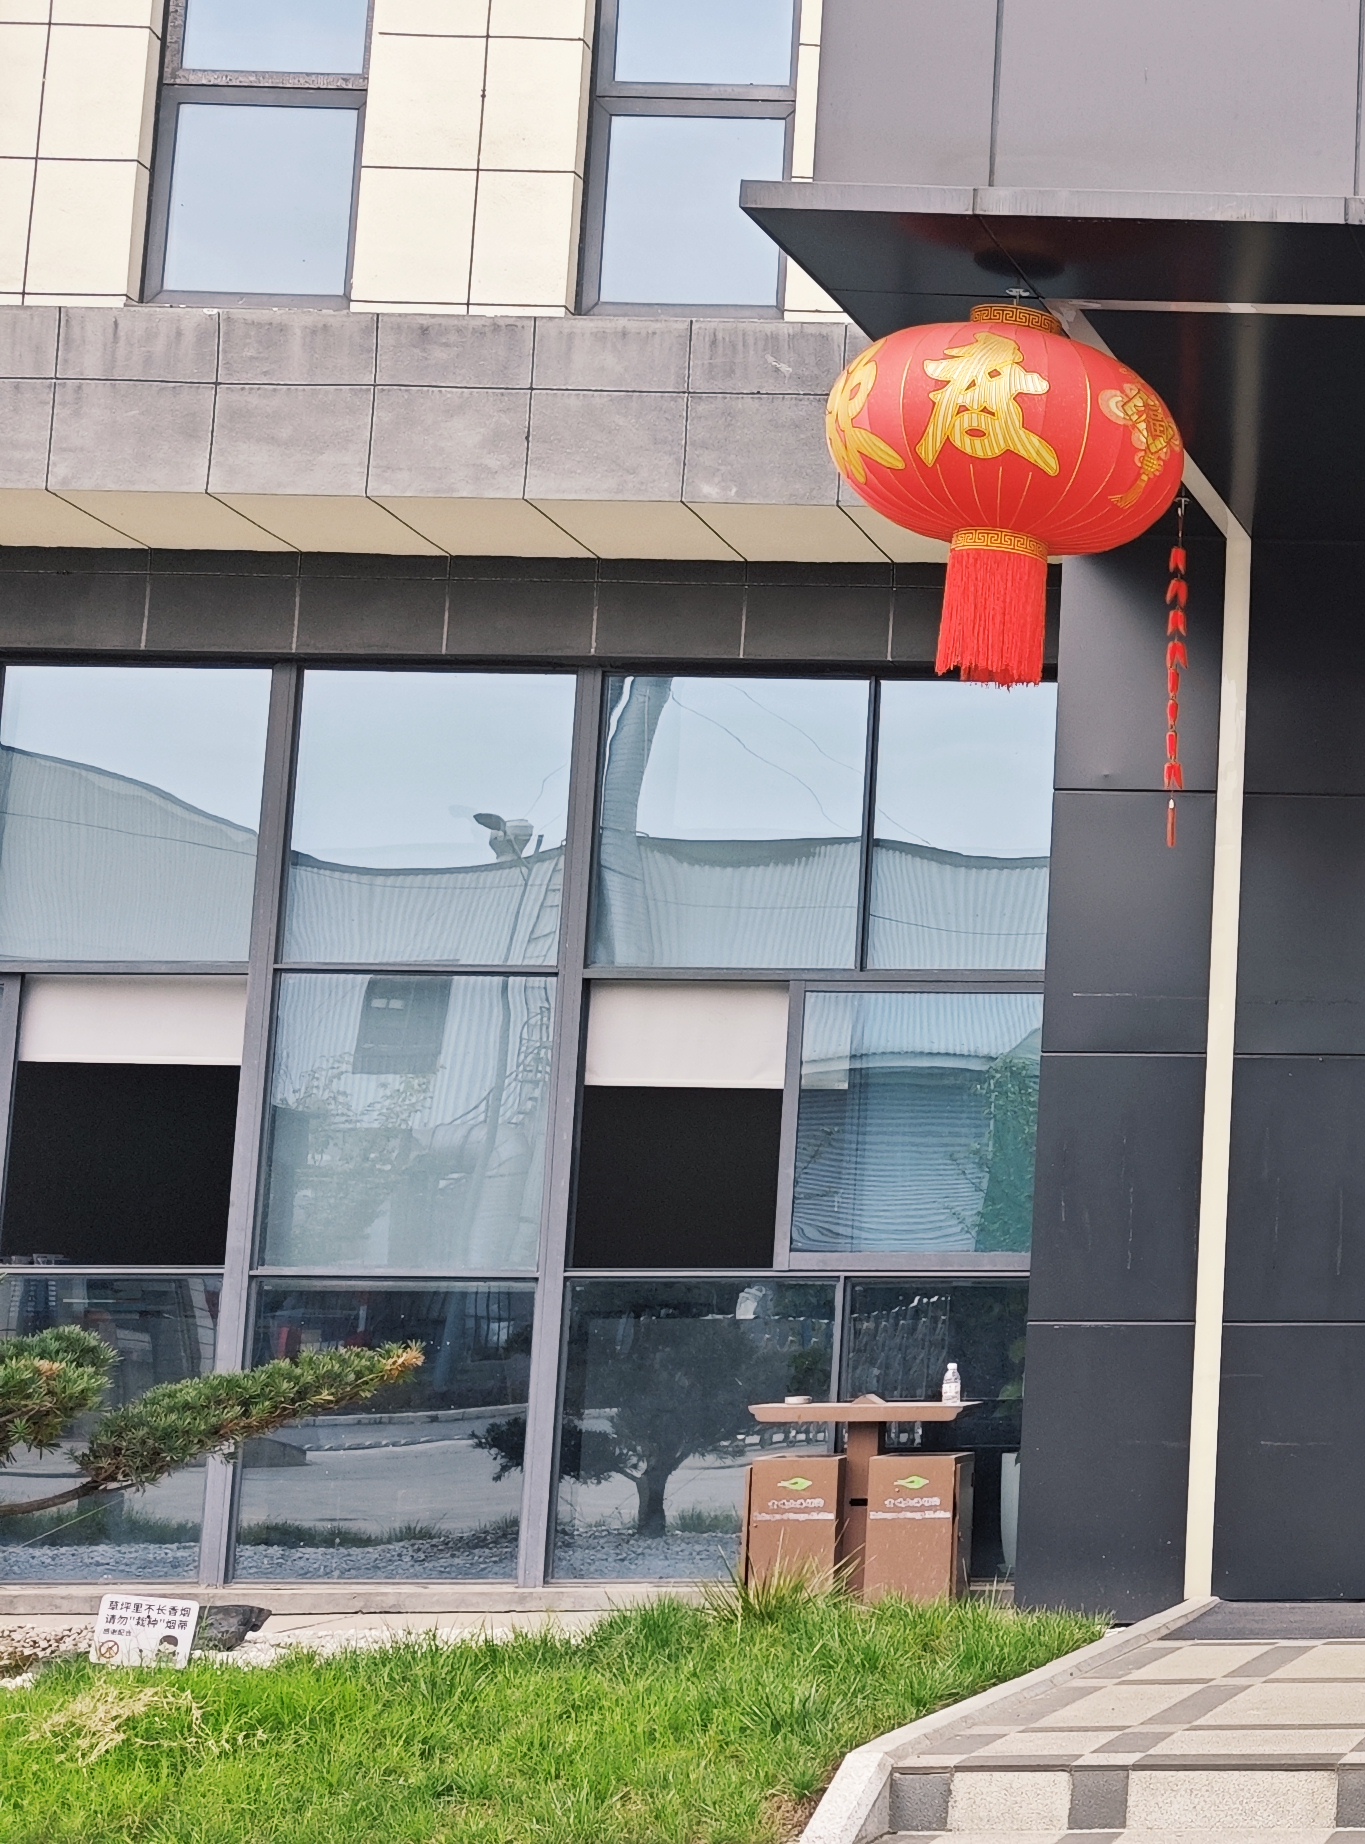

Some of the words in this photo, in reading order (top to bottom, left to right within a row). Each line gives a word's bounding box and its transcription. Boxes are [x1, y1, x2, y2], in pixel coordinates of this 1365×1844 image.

[916, 331, 1060, 477] 春
[108, 1600, 191, 1617] 草坪里不长香烟
[102, 1628, 132, 1636] 感谢配合
